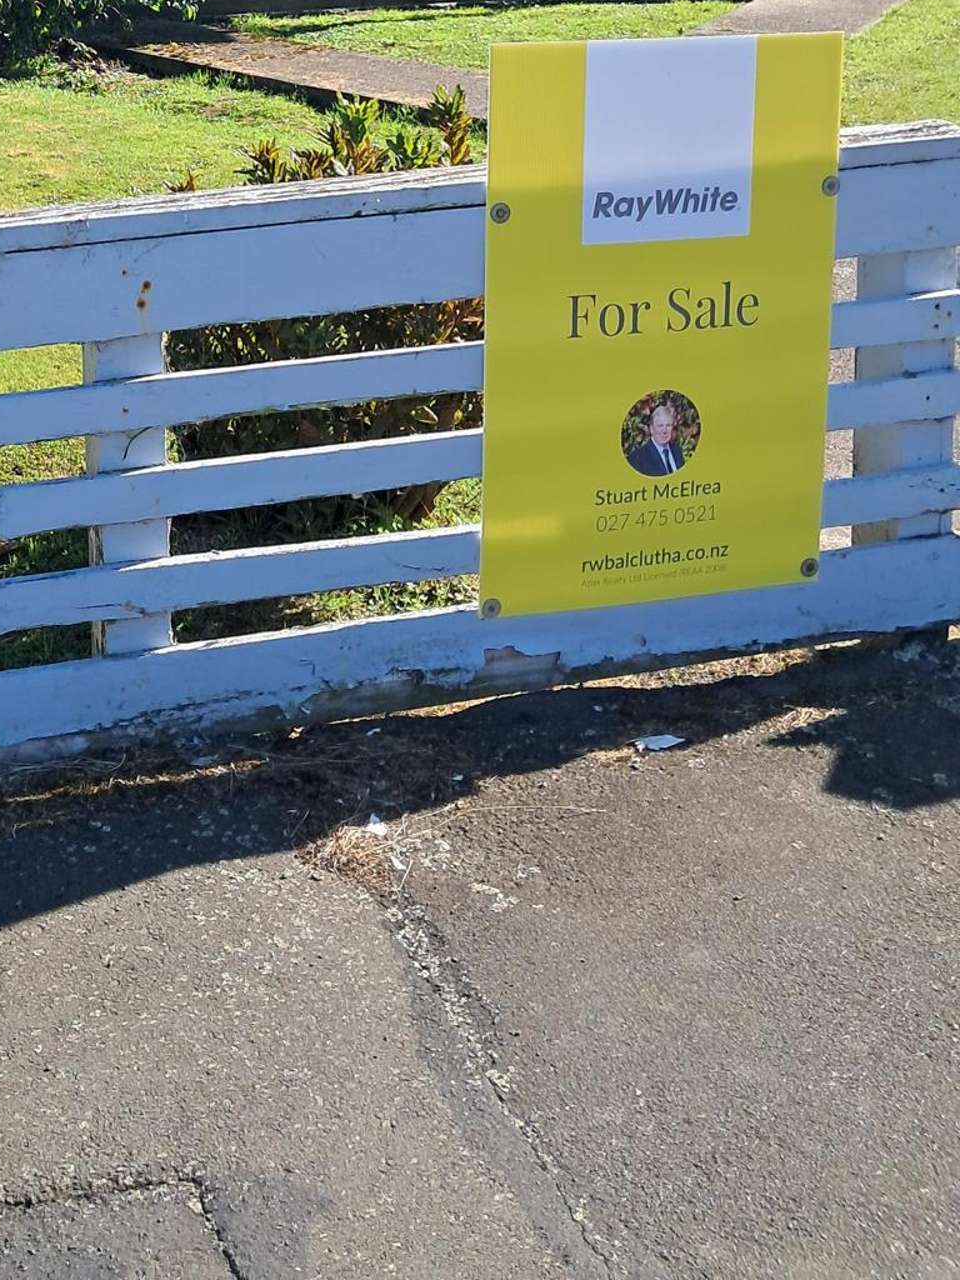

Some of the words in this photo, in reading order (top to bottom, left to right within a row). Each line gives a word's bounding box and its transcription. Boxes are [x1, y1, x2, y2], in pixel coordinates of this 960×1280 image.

[568, 295, 651, 339] For
[666, 281, 759, 332] Sale
[595, 487, 647, 505] Stuart
[653, 480, 721, 500] McElrea
[596, 513, 630, 532] 027
[635, 509, 668, 528] 475
[674, 504, 717, 524] 0521
[581, 545, 729, 572] rwbalclutha.co.nz
